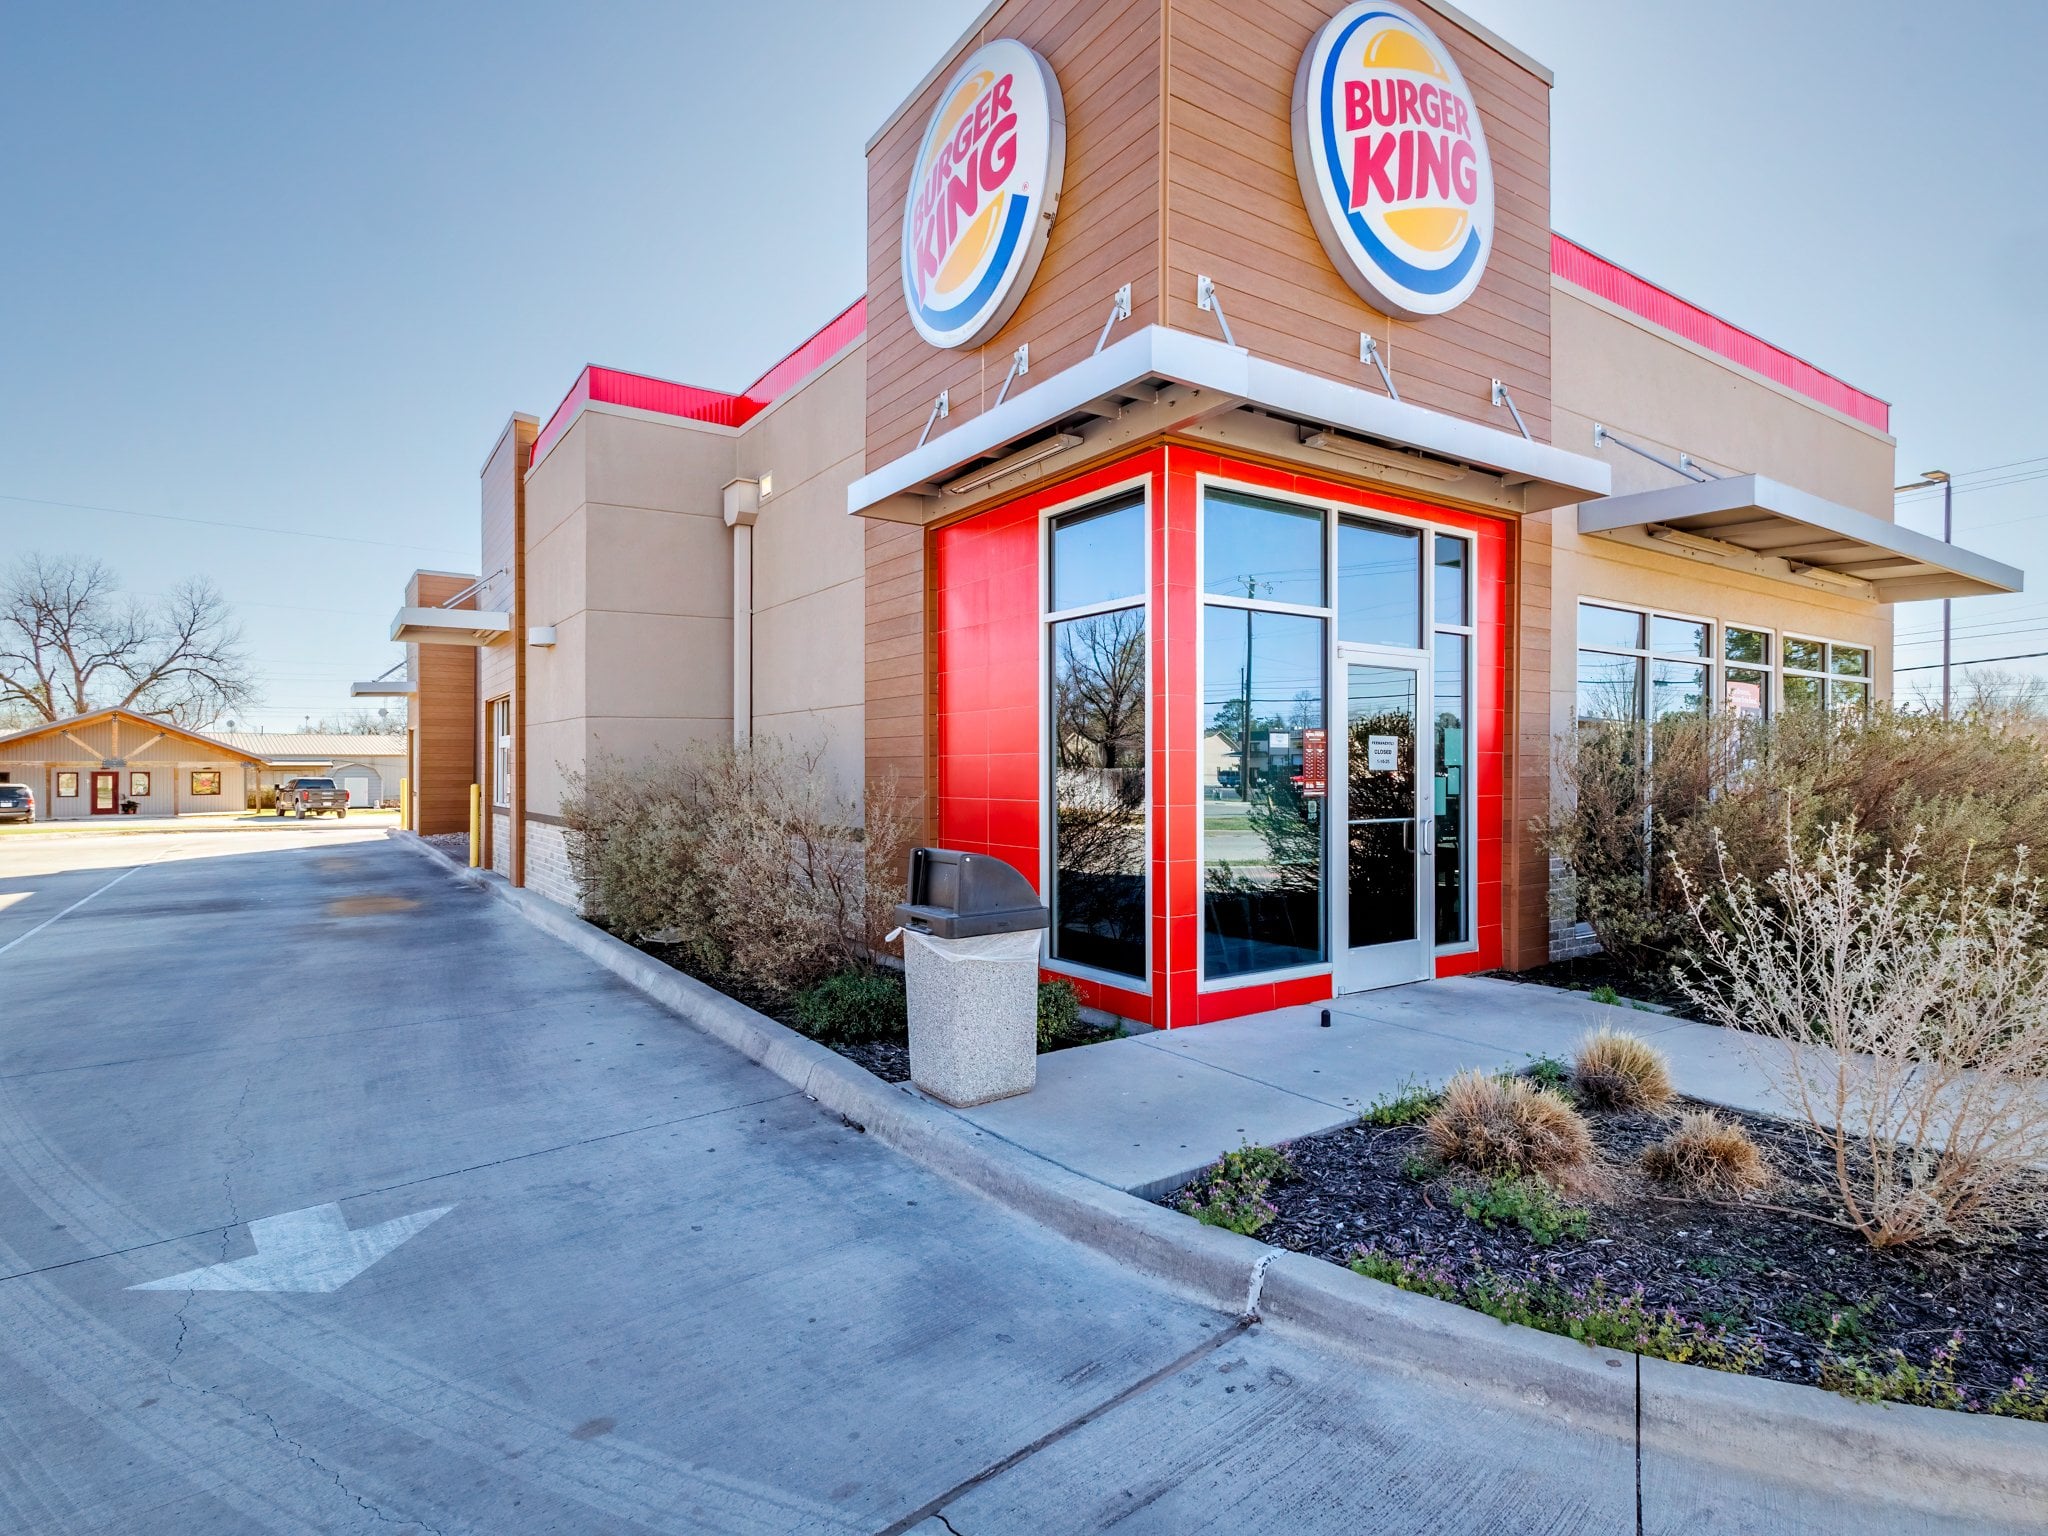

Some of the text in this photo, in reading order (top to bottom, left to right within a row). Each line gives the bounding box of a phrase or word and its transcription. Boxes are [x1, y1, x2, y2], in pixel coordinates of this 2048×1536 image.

[913, 73, 1013, 249] BURGER
[1344, 78, 1471, 141] BURGER
[1350, 130, 1478, 209] KING
[917, 112, 1018, 311] KING
